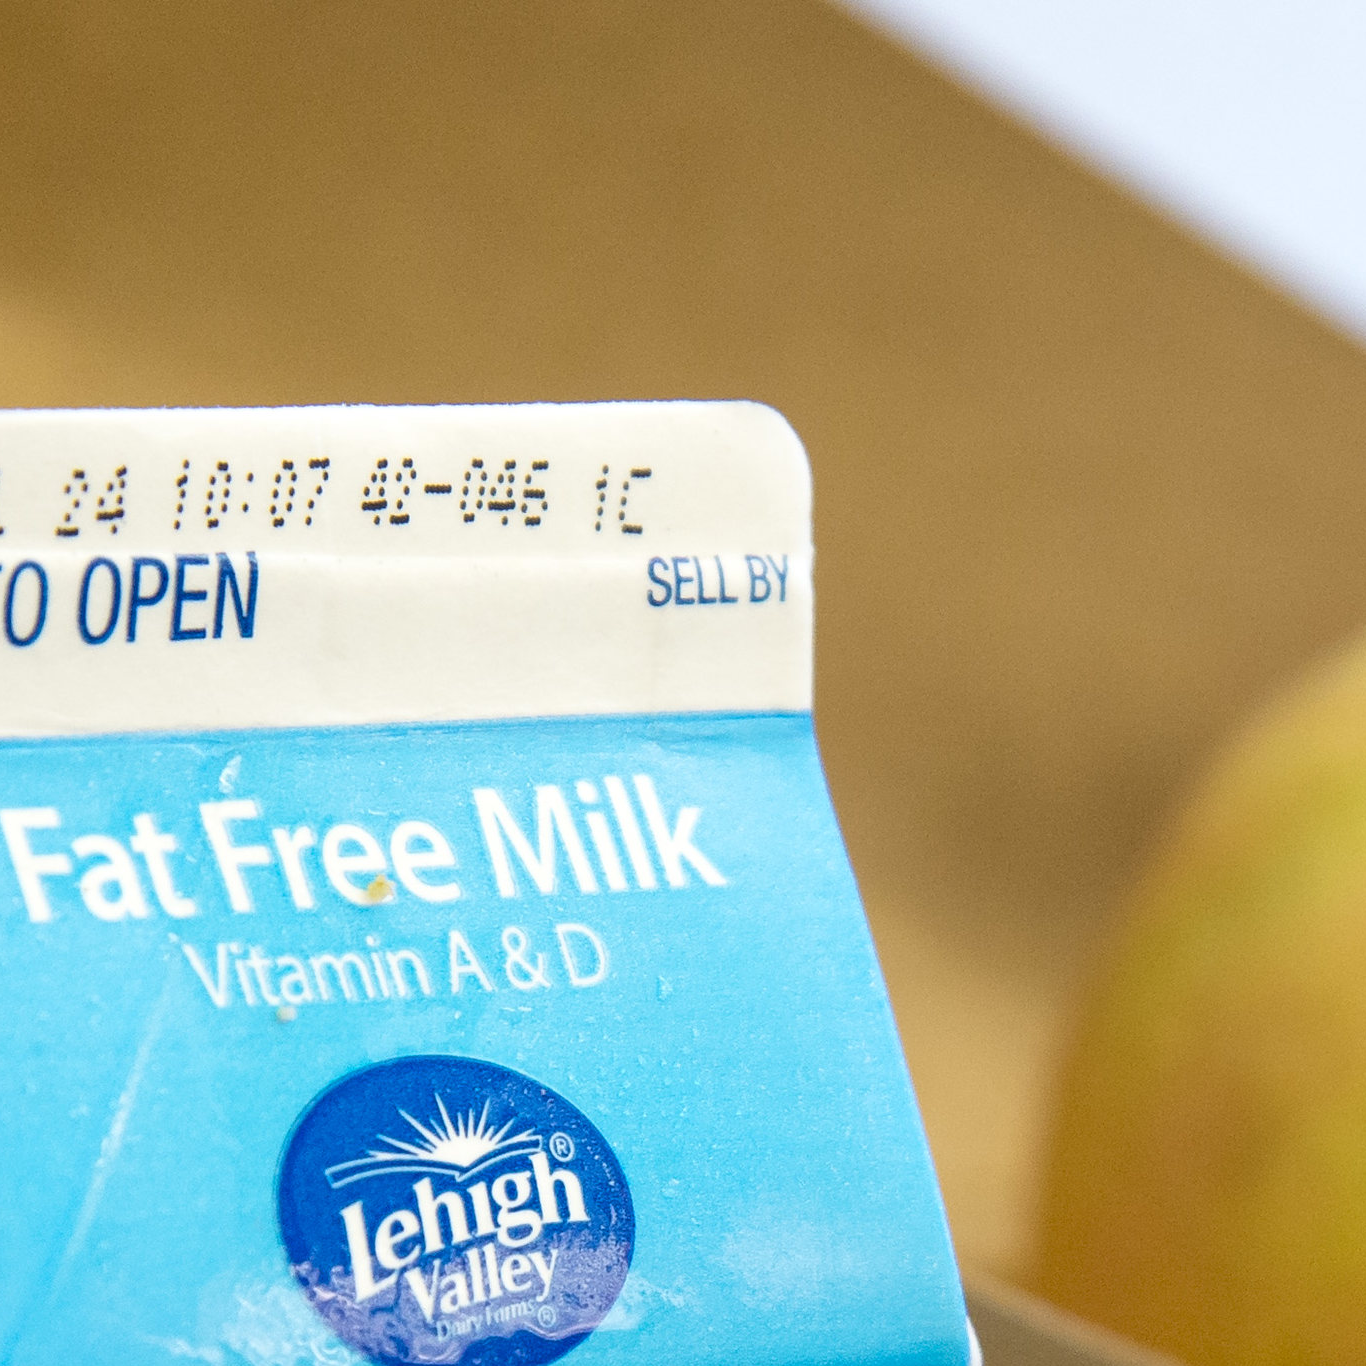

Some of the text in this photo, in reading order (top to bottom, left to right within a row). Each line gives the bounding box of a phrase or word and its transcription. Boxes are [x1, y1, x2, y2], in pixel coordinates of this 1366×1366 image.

[55, 465, 127, 537] 24
[172, 457, 330, 531] 10:07
[77, 551, 259, 646] OPEN
[647, 553, 790, 608] SELL BY
[199, 796, 463, 915] Free
[472, 772, 731, 899] Milk
[181, 921, 609, 1010] Vitamin A & D
[340, 1151, 591, 1303] Lehigh
[403, 1246, 559, 1324] Valley
